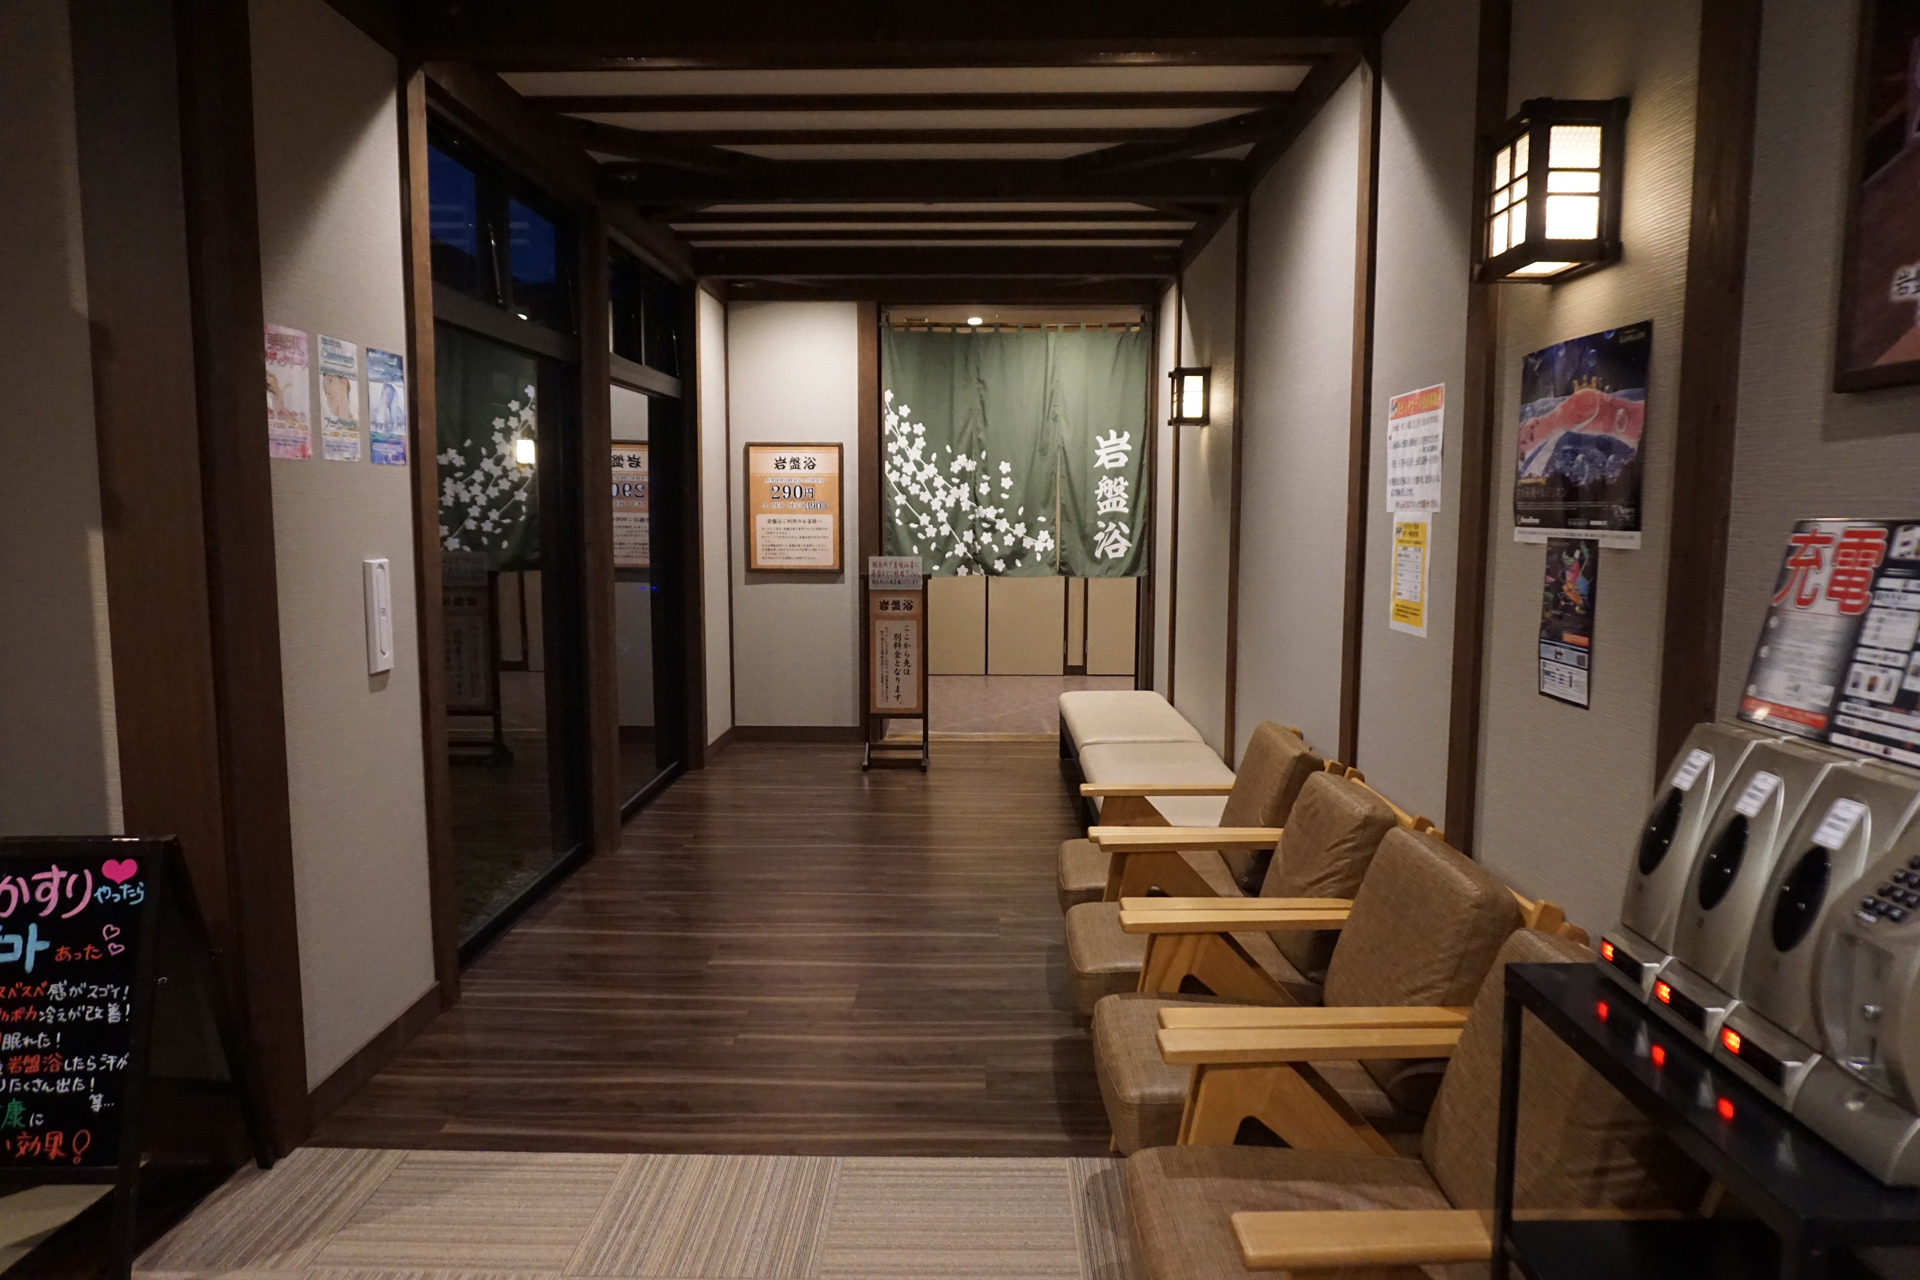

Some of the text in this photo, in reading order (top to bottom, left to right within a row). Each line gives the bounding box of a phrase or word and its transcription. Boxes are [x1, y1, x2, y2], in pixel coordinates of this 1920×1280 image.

[773, 456, 817, 471] 岩盤浴
[771, 484, 814, 500] 290円
[1093, 429, 1132, 559] 岩盤浴
[1772, 525, 1888, 615] 充電
[879, 599, 914, 611] 岩盤浴
[893, 632, 903, 705] 別料金となります。
[903, 624, 912, 676] ここから先は
[0, 864, 145, 919] かすり やったら
[55, 944, 103, 962] あった
